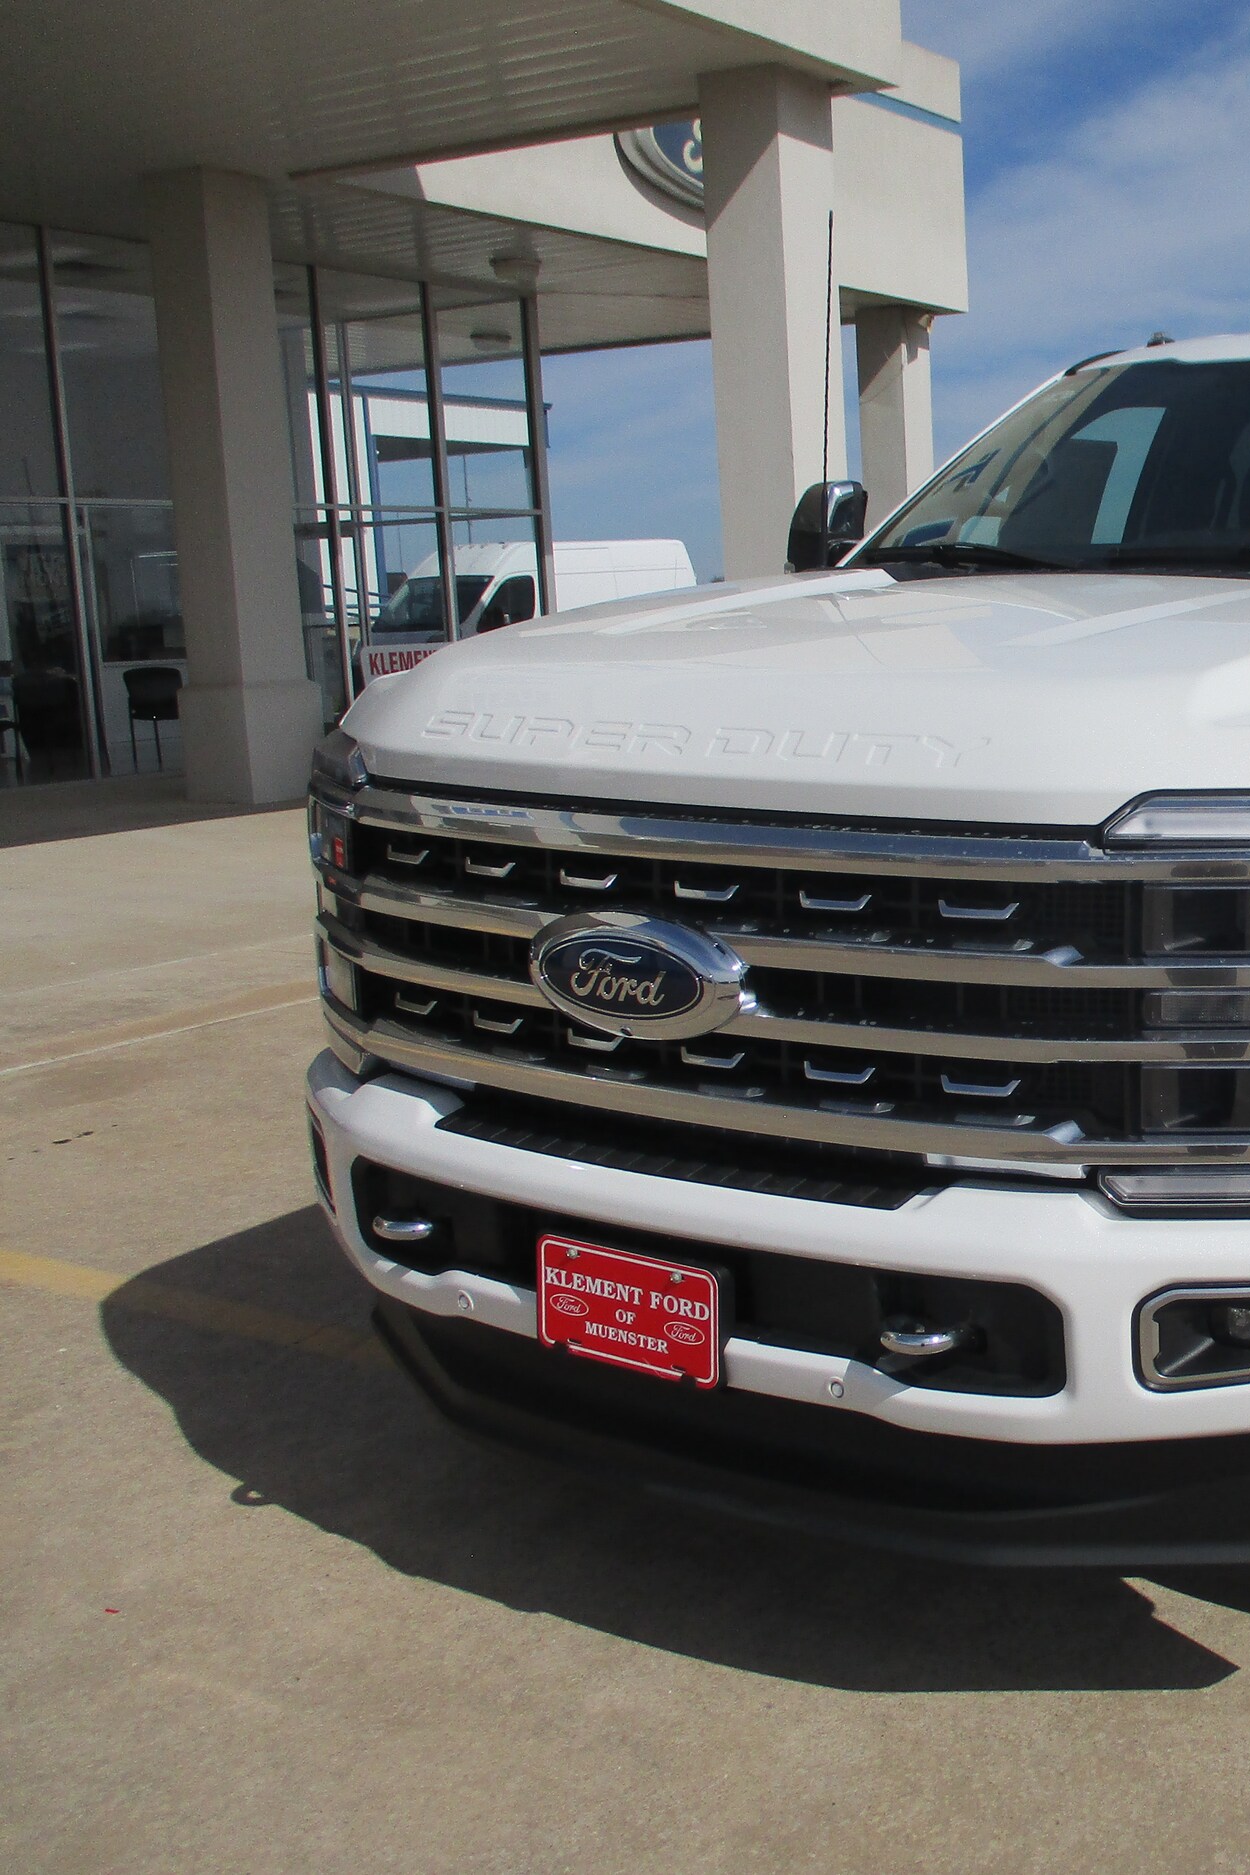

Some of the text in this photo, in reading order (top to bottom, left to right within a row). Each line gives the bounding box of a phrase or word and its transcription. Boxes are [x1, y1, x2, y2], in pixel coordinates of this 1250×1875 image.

[421, 710, 990, 768] SUPER DUTY
[570, 948, 666, 1006] Ford
[544, 1266, 710, 1321] KLEMENT FORD
[556, 1295, 582, 1314] Ford
[615, 1308, 636, 1325] OF
[584, 1321, 669, 1354] MUENSTER
[670, 1324, 698, 1343] Ford
